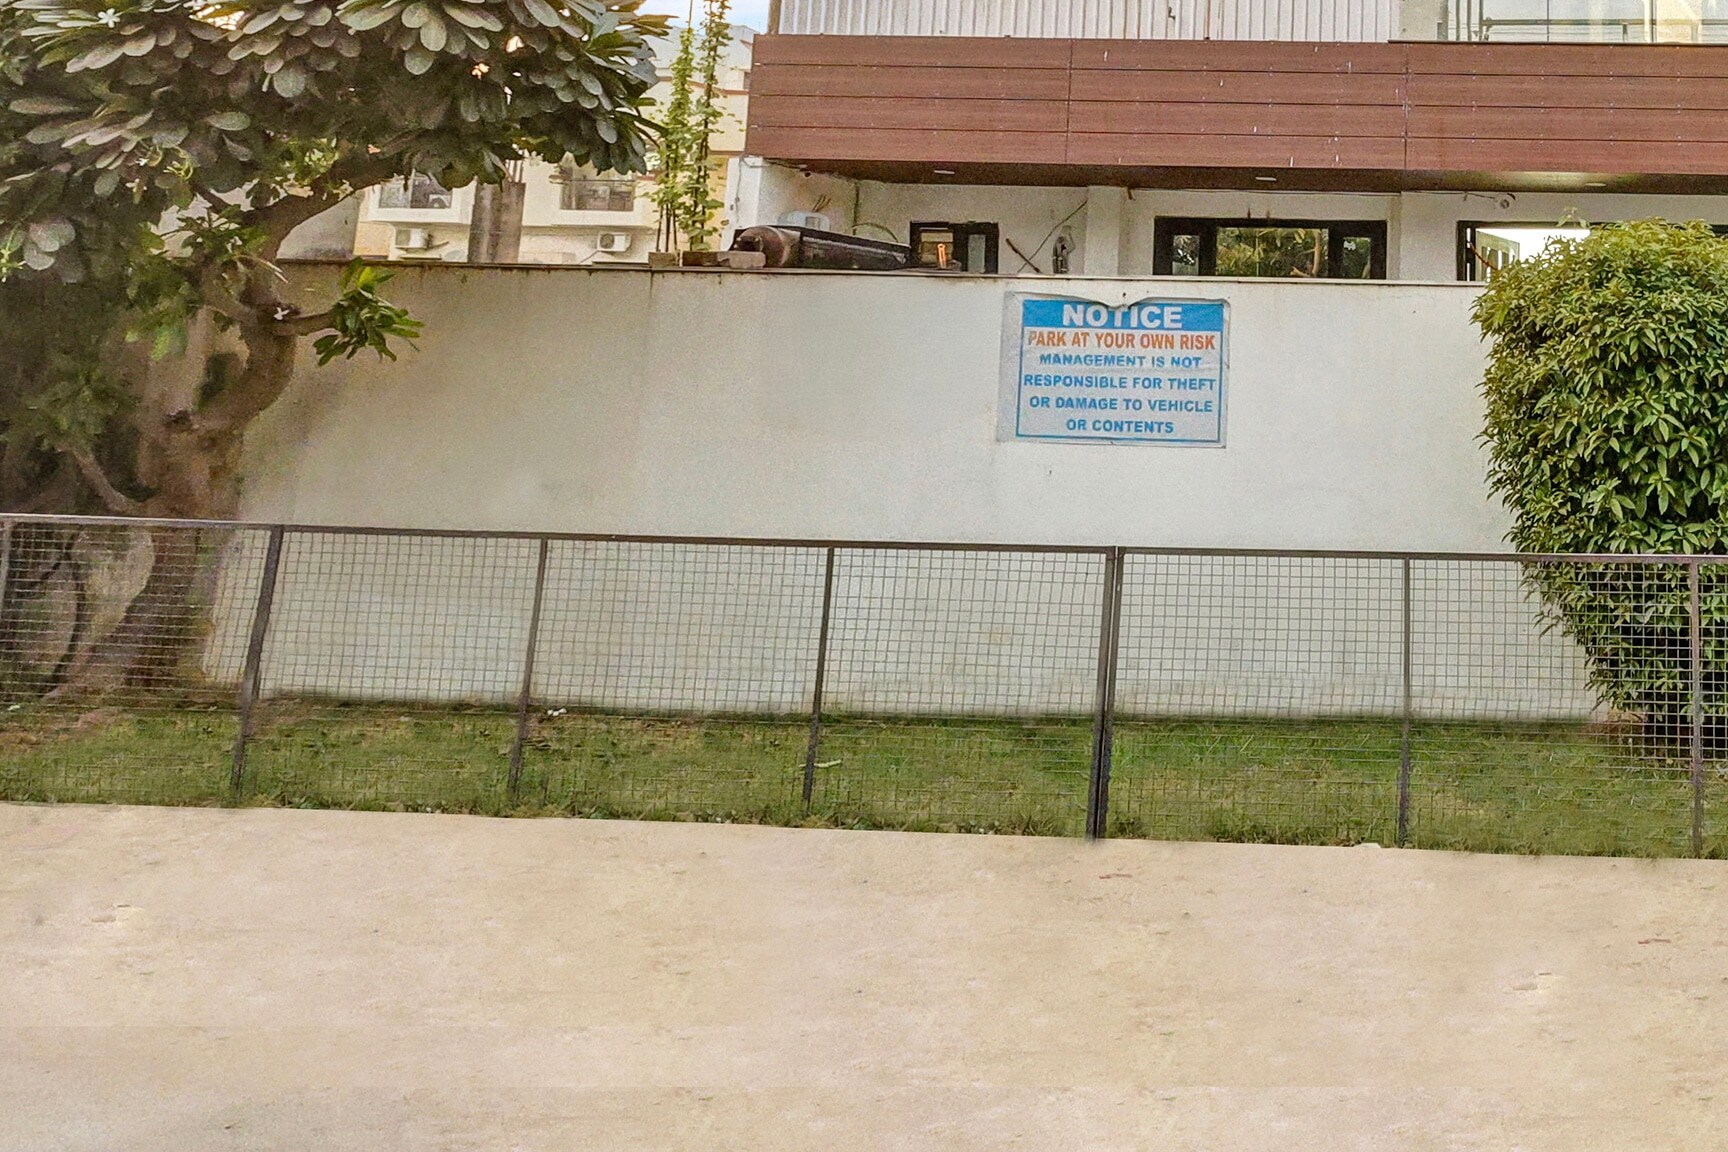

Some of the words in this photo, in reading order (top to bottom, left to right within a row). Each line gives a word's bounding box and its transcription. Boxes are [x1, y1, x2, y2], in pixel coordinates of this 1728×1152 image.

[1062, 304, 1183, 329] NOTICE
[1028, 330, 1067, 347] PARK
[1071, 332, 1089, 347] AT
[1095, 332, 1135, 348] YOUR
[1140, 334, 1174, 349] OWN
[1180, 334, 1215, 350] RISK
[1039, 353, 1146, 367] MANAGEMENT
[1151, 355, 1165, 367] IS
[1171, 356, 1202, 368] NOT
[1023, 373, 1127, 389] RESPONSIBLE
[1132, 376, 1162, 390] FOR
[1167, 377, 1217, 391] THEFT
[1029, 395, 1050, 409] OR
[1055, 396, 1118, 410] DAMAGE
[1123, 398, 1143, 411] TO
[1149, 399, 1213, 413] VEHICLE
[1066, 419, 1086, 431] OR
[1092, 419, 1174, 434] CONTENTS
